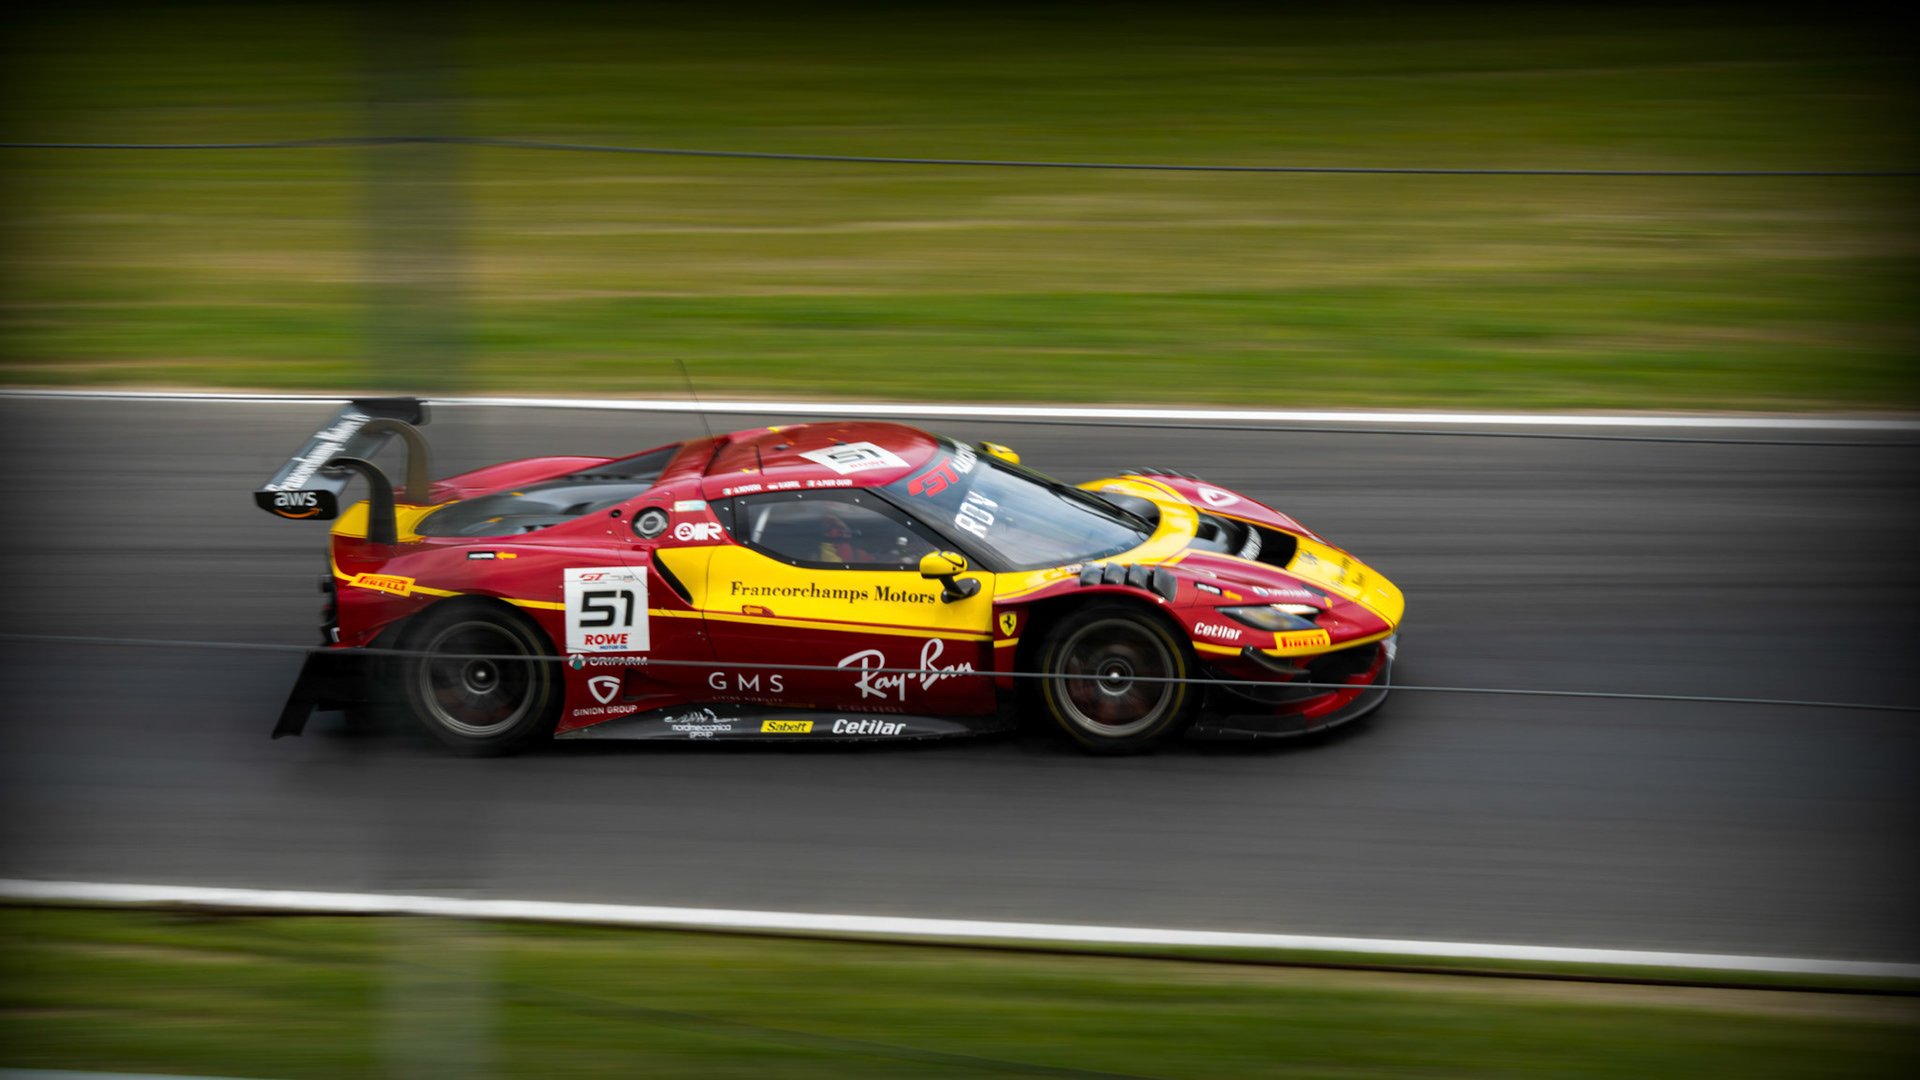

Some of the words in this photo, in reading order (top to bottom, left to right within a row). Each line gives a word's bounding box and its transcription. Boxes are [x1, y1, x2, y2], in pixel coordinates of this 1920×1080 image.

[827, 448, 882, 464] 51
[908, 457, 959, 497] GT
[274, 491, 318, 507] aws
[357, 575, 408, 592] PIRELLI
[730, 581, 869, 604] Francorchamps
[874, 585, 936, 604] Motors
[579, 590, 635, 628] 51
[584, 633, 628, 645] ROWE
[1194, 622, 1243, 640] Cetilar
[1281, 634, 1326, 648] PIRELLI
[837, 638, 975, 701] Ray-Ban
[573, 707, 605, 717] GINION
[606, 705, 638, 715] GROUP
[767, 721, 807, 732] Sabelt
[832, 719, 906, 735] Cetilar
[689, 731, 714, 739] group
